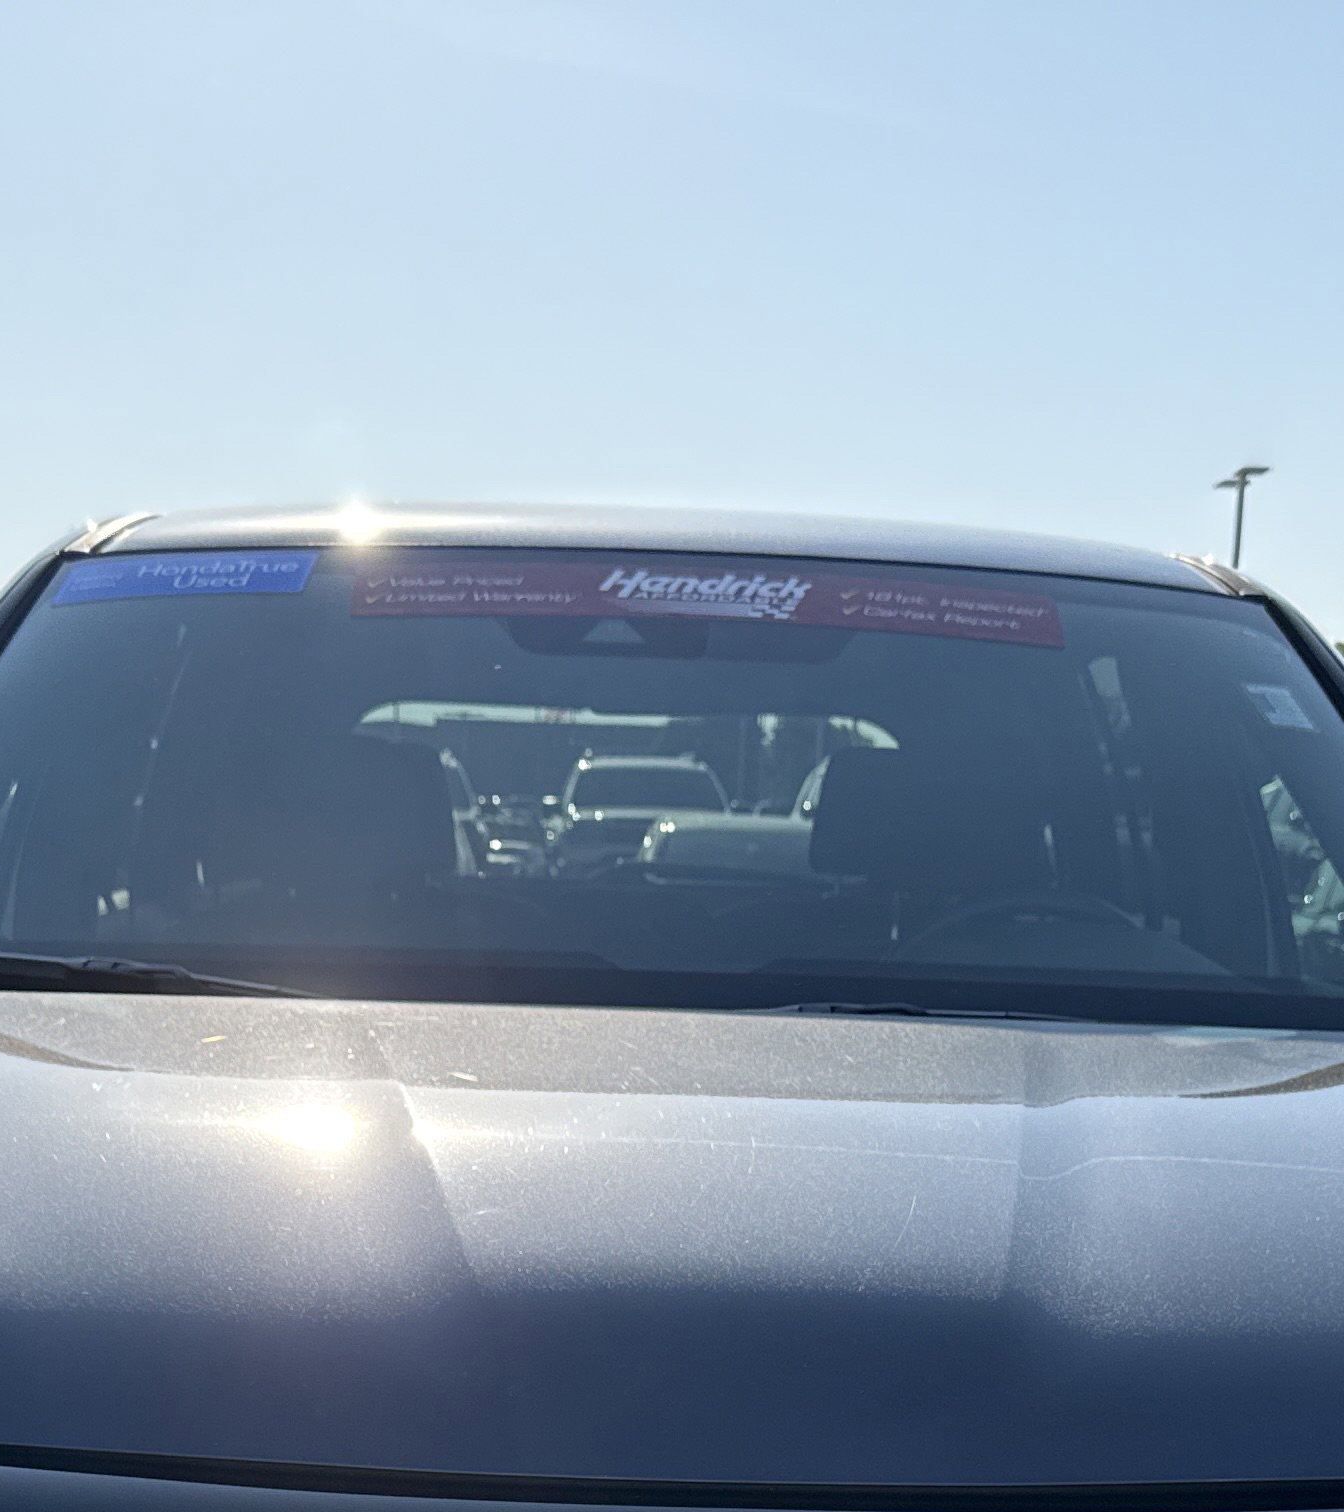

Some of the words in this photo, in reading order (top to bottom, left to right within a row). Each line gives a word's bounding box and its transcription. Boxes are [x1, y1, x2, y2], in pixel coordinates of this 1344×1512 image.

[137, 559, 299, 578] HondaTrue
[173, 575, 250, 588] Used
[599, 568, 812, 600] Hendrick
